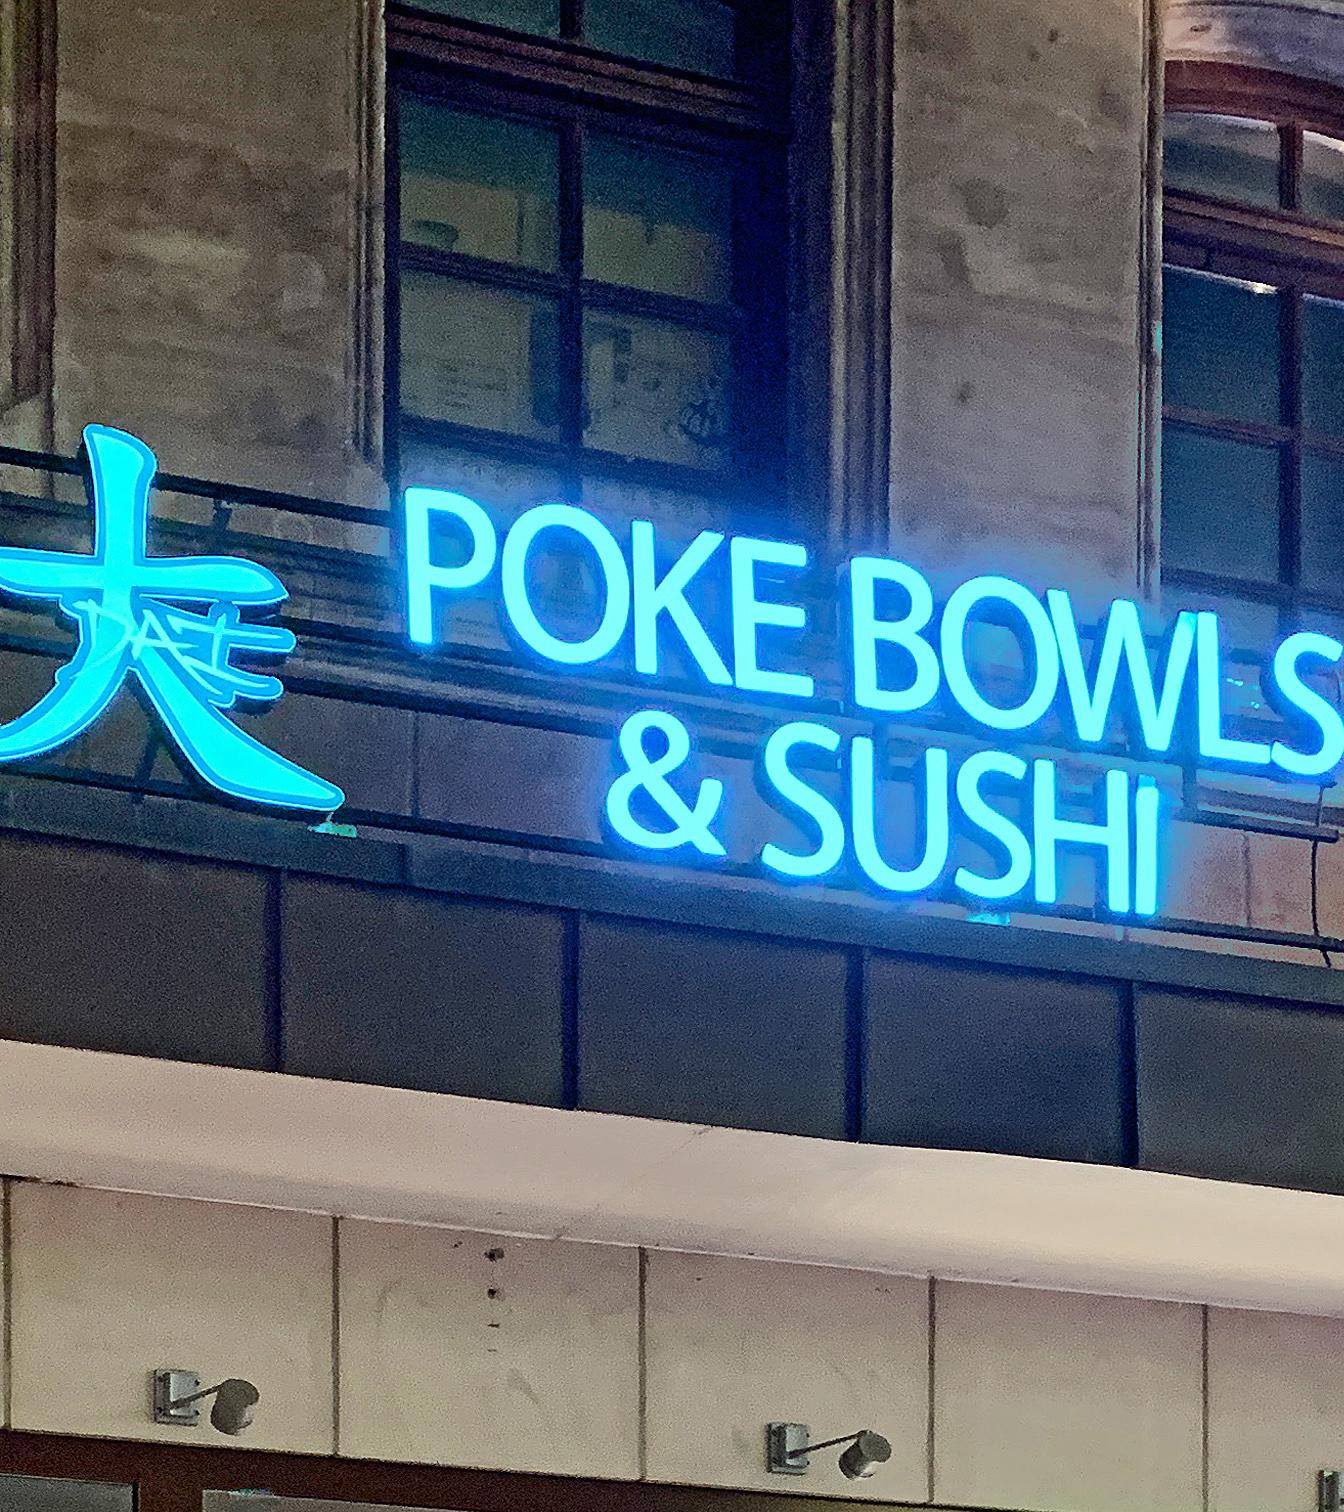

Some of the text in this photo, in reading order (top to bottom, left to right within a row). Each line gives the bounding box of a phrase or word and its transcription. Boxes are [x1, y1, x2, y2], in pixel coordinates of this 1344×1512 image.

[404, 485, 814, 698] POKE
[604, 709, 1160, 917] & SUSHI
